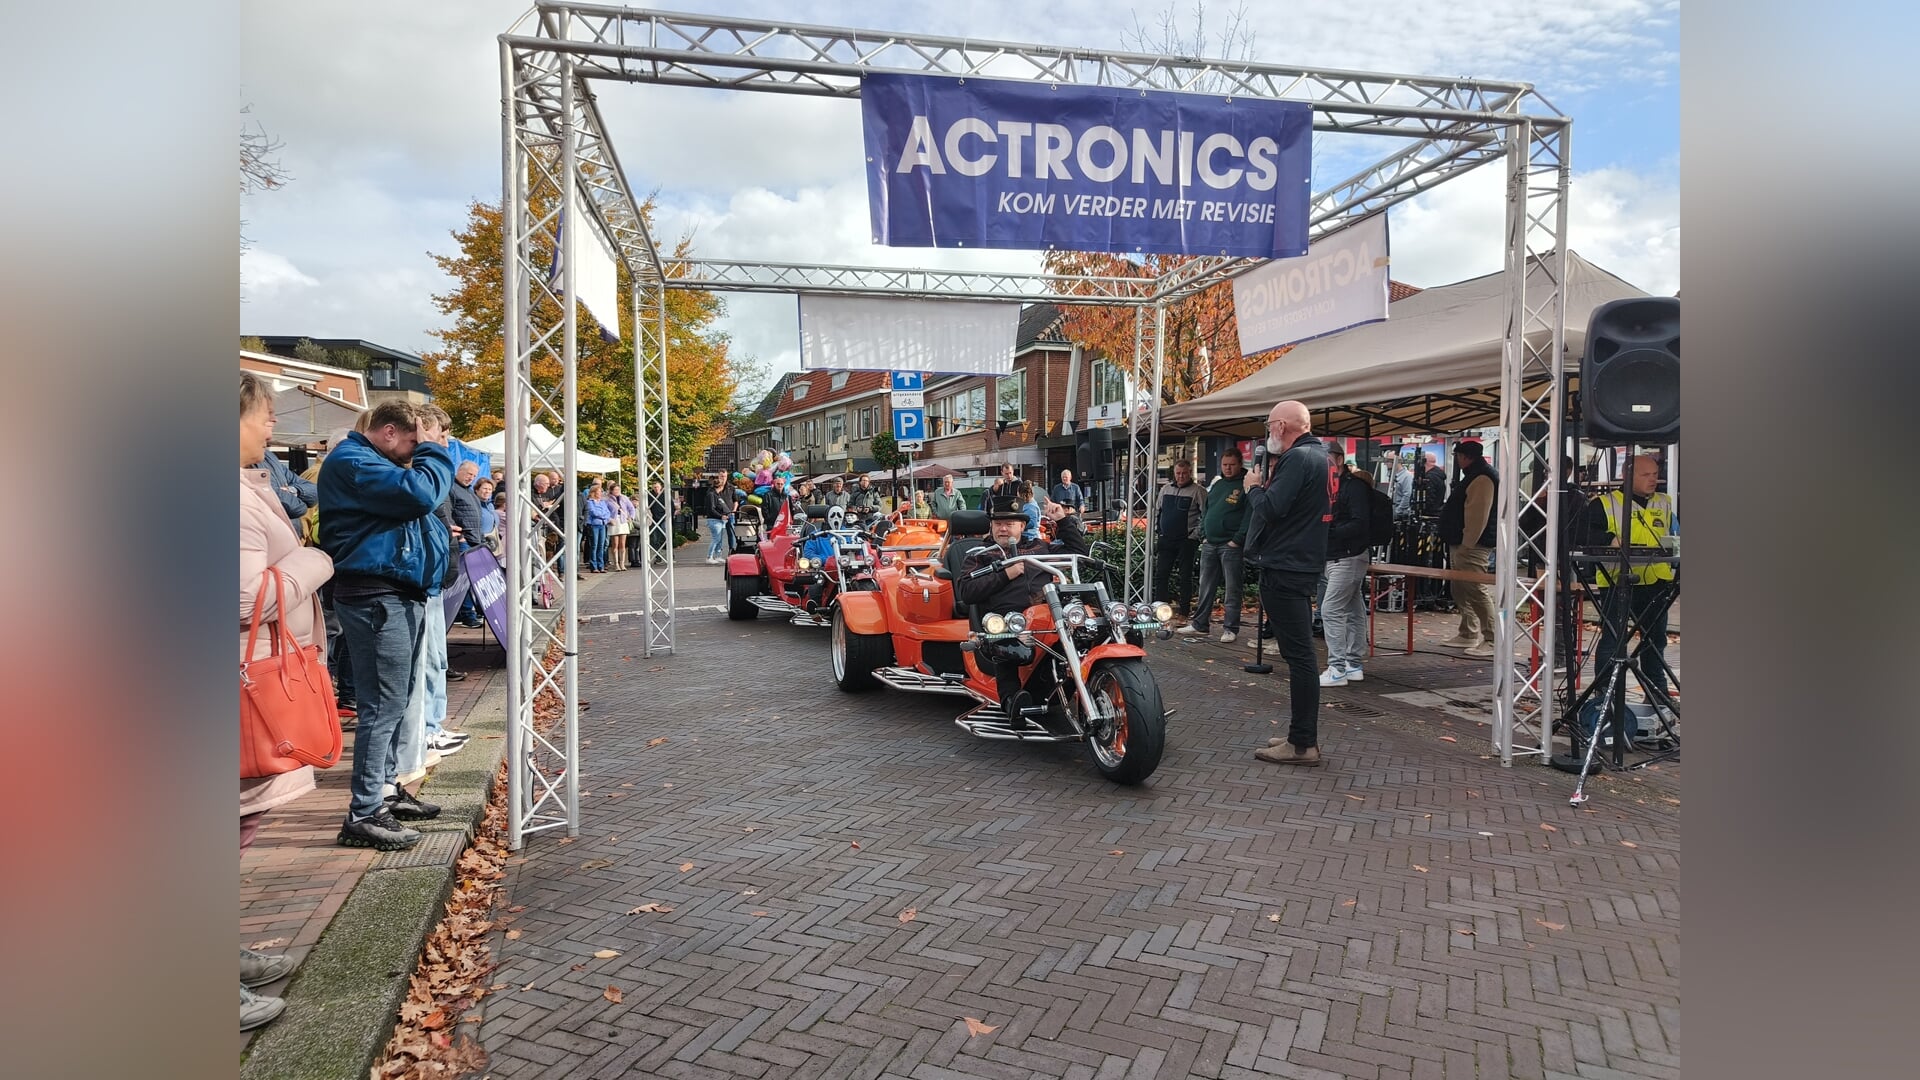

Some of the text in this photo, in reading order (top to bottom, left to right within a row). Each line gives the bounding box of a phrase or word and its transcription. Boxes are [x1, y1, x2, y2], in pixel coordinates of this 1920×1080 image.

[896, 115, 1279, 191] ACTRONICS
[998, 191, 1276, 224] KOM VERDER MET REVISIE
[900, 412, 918, 437] P
